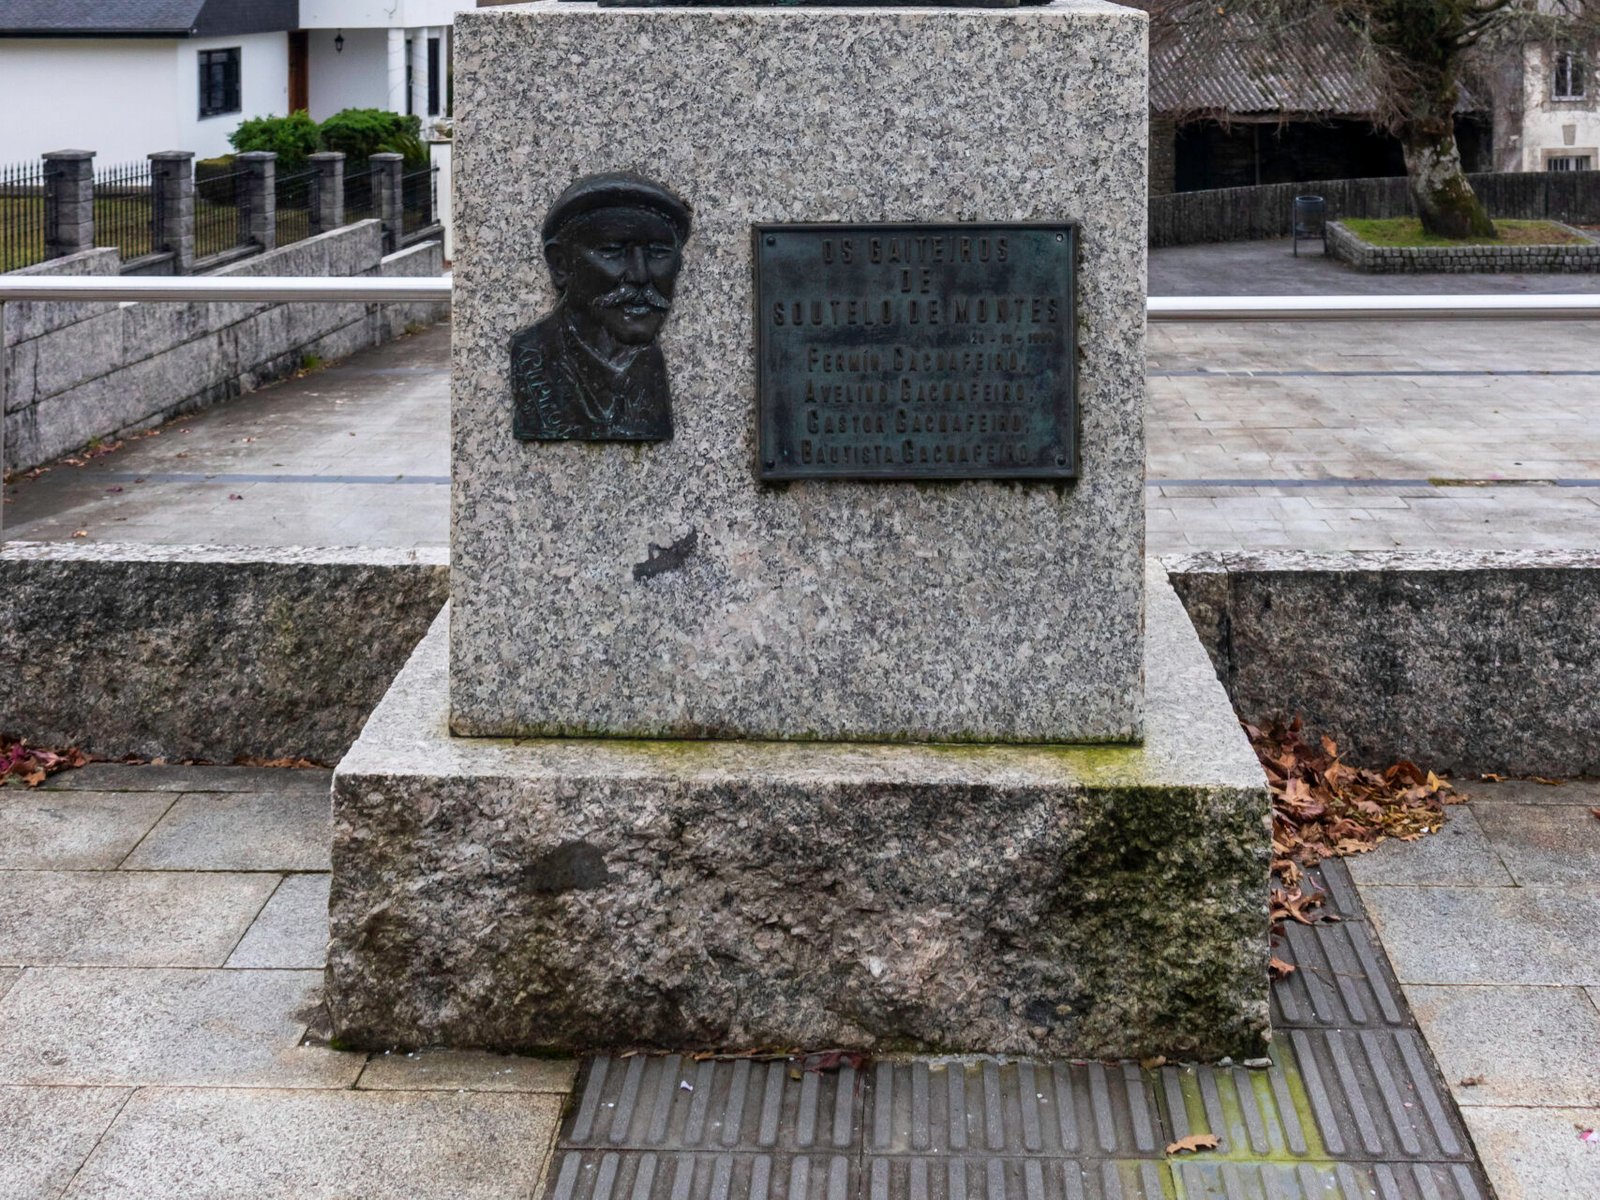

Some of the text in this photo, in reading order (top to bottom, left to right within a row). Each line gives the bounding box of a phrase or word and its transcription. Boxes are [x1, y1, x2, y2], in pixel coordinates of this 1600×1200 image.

[822, 235, 1009, 264] OS GAITEIROS
[901, 267, 931, 293] DE
[773, 298, 1059, 326] SOUTELO DE MONTES
